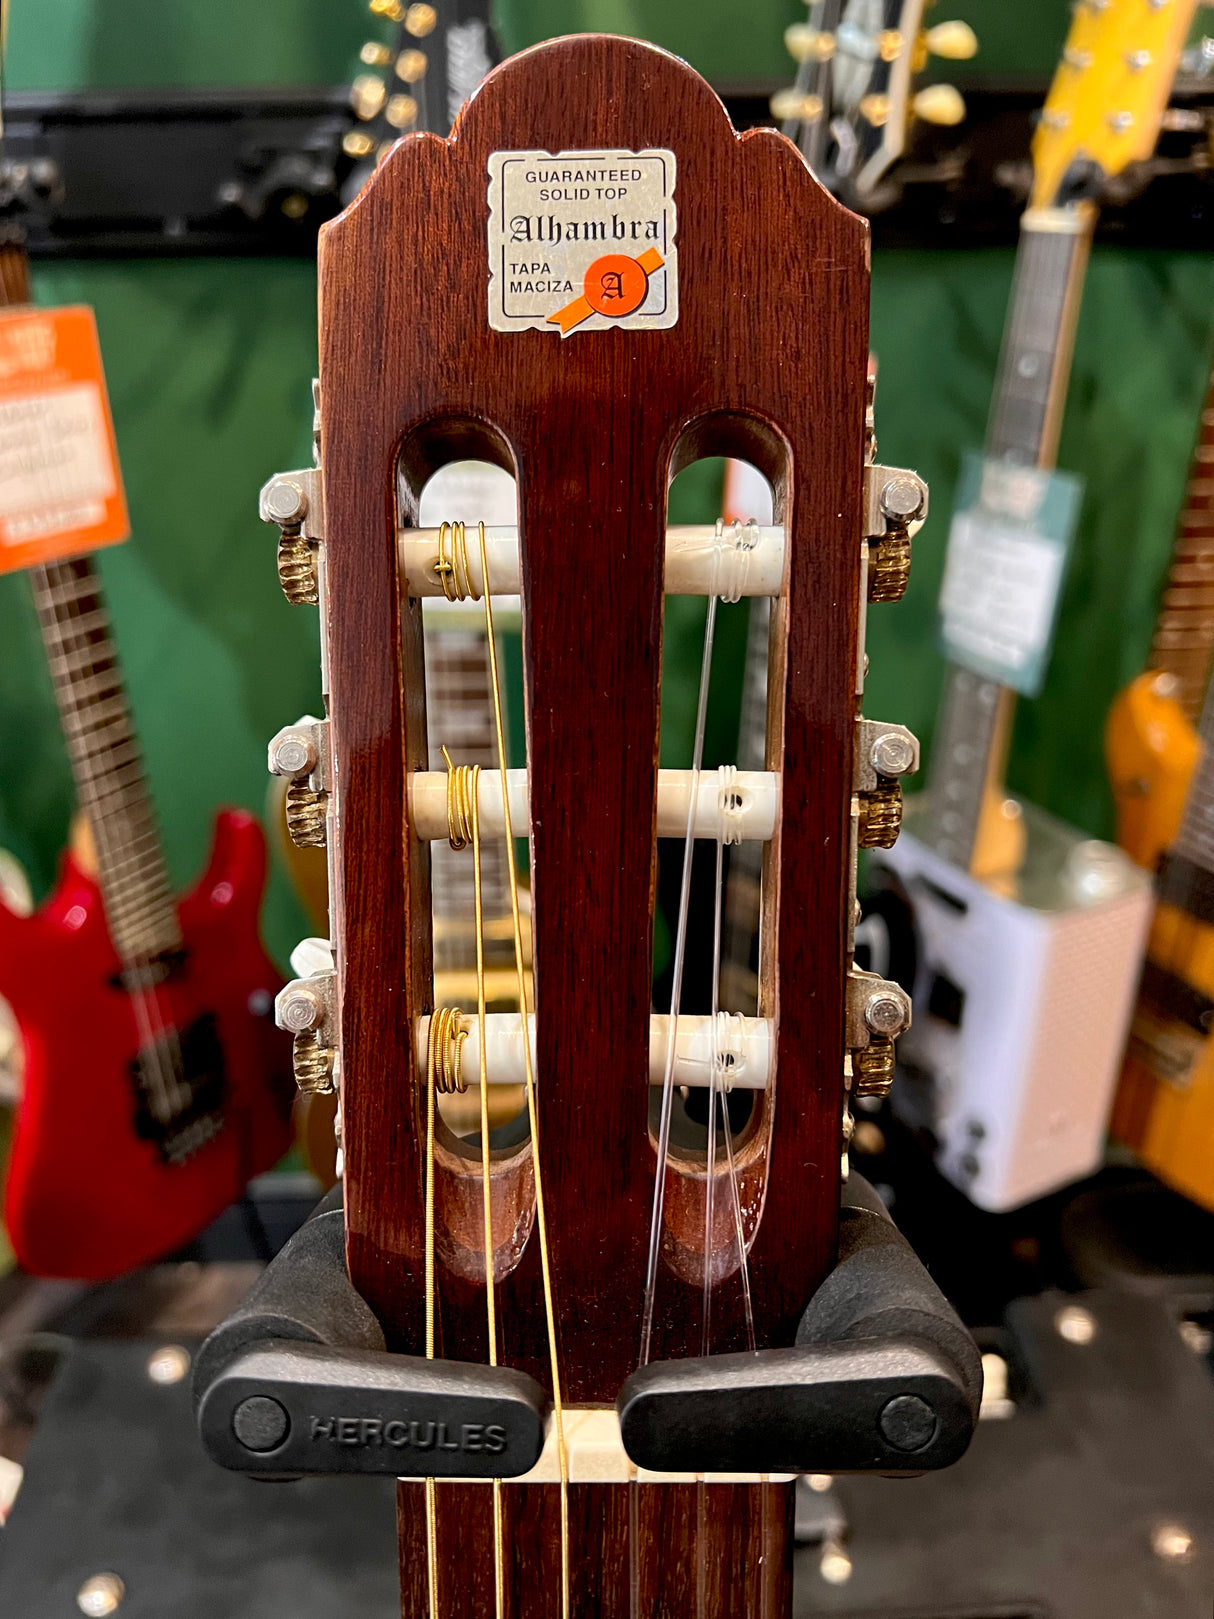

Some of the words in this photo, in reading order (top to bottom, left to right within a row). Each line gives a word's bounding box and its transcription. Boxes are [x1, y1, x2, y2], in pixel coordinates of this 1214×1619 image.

[526, 170, 642, 183] GUARANTEED
[539, 188, 590, 201] SOLID
[595, 188, 628, 200] TOP
[510, 214, 660, 247] Alhambra
[510, 263, 551, 275] TAPA
[510, 281, 574, 293] MACIZA
[600, 271, 626, 300] A
[309, 1415, 507, 1451] HERCULES
